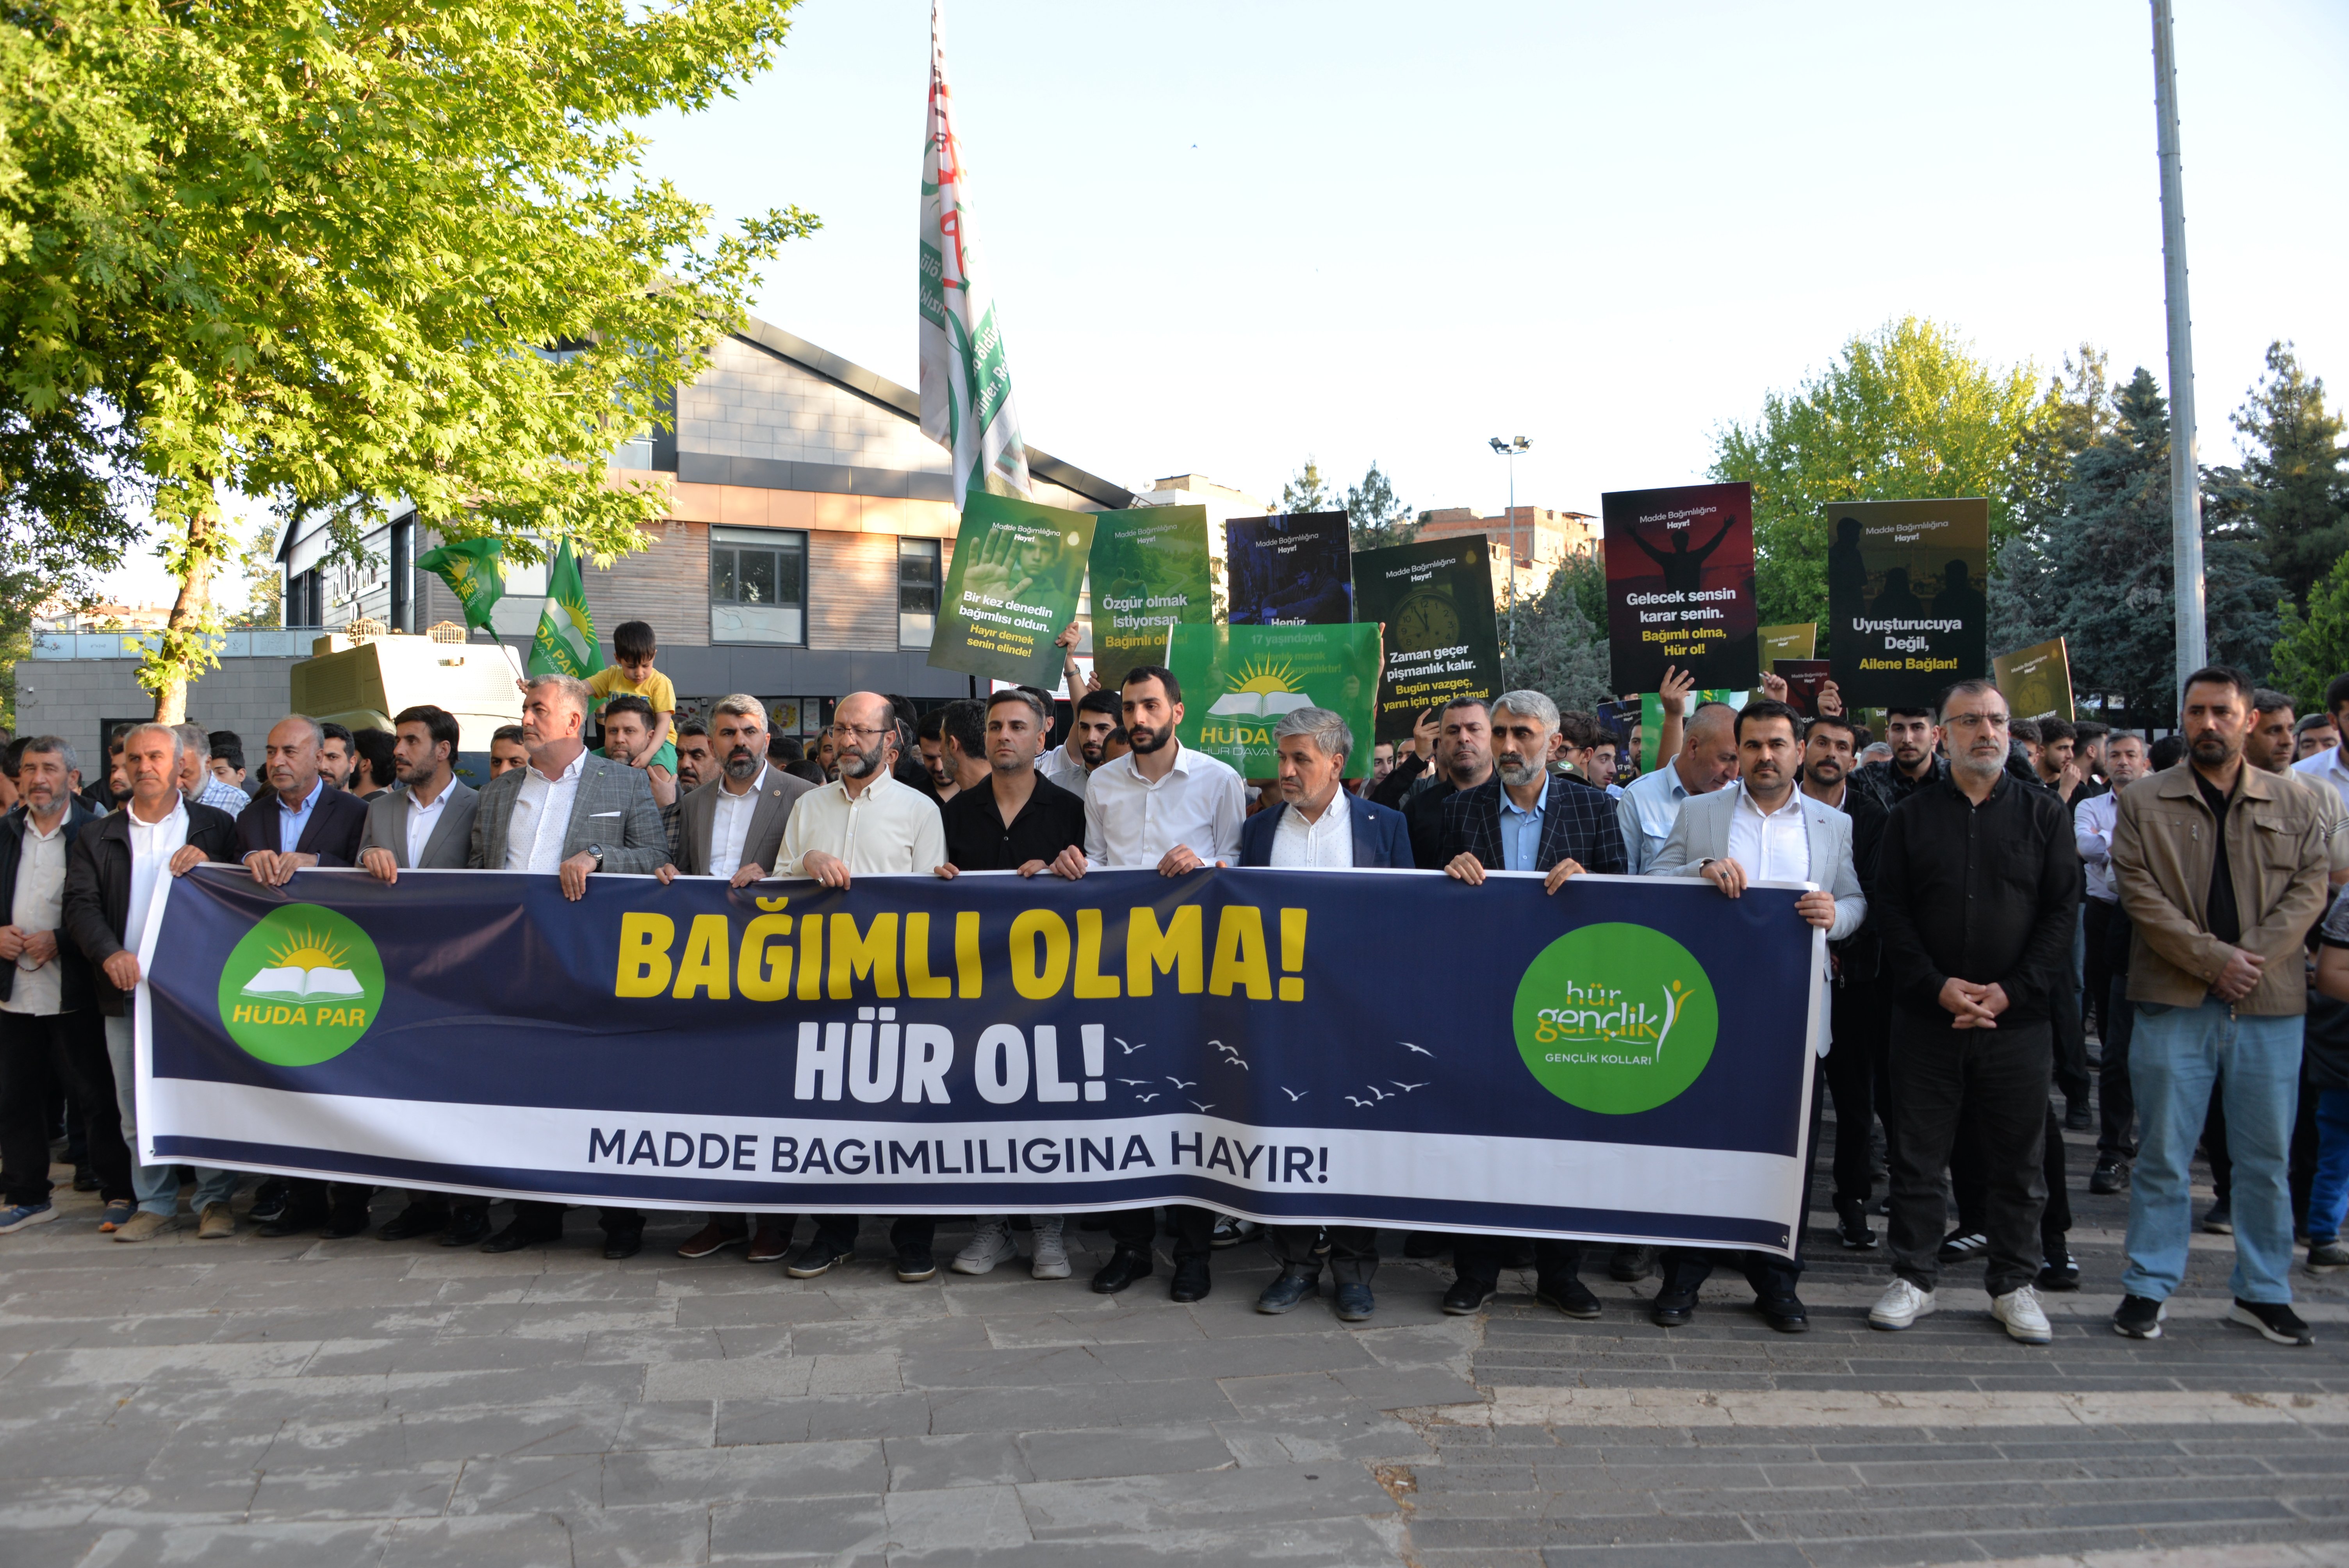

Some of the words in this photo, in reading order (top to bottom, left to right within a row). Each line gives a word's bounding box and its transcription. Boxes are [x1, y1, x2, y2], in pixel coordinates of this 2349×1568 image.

[1640, 513, 1666, 523] Madde
[1668, 506, 1716, 519] Bağımlılığına
[992, 522, 1016, 531] Madde
[1018, 525, 1060, 537] Bağımlılığına
[1115, 530, 1136, 539] Madde
[1138, 524, 1177, 535] Bağımlılığına
[1667, 519, 1690, 529] Hayır!
[1866, 526, 1895, 535] Madde
[1896, 521, 1948, 533] Bağımlılığına
[1014, 533, 1035, 543] Hayır!
[1137, 535, 1156, 544] Hayır!
[1256, 538, 1278, 548] Madde
[1279, 533, 1319, 544] Bağımlılığına
[1895, 533, 1919, 543] Hayır!
[1278, 545, 1297, 554] Hayır!
[1386, 567, 1410, 578] Madde
[1411, 558, 1456, 572] Bağımlılığına
[1411, 571, 1432, 582] Hayır!
[963, 591, 981, 603] Bir
[982, 594, 1004, 608] kez
[1005, 600, 1053, 618] denedin
[1103, 594, 1143, 612] Özgür
[1146, 593, 1187, 608] olmak
[1626, 590, 1685, 606] Gelecek
[1688, 588, 1736, 602] sensin
[959, 605, 1012, 625] bağımlısı
[1014, 618, 1050, 633] oldun.
[1113, 615, 1182, 630] istiyorsan.
[1271, 617, 1306, 628] Henüz
[1640, 611, 1677, 623] karar
[1681, 607, 1724, 620] senin.
[1853, 617, 1962, 634] Uyuşturucuya
[970, 624, 997, 637] Hayır
[999, 631, 1034, 645] demek
[1105, 634, 1151, 650] Bağımlı
[1251, 634, 1263, 644] 17
[1265, 632, 1327, 647] yaşındaydı,
[1642, 629, 1689, 643] Bağımlı
[1692, 627, 1726, 639] olma,
[967, 638, 995, 650] senin
[997, 644, 1032, 657] elinde!
[1664, 644, 1687, 656] Hür
[1690, 643, 1705, 655] ol!
[1885, 636, 1930, 653] Değil,
[1295, 651, 1326, 661] merak
[1390, 650, 1431, 663] Zaman
[1433, 645, 1469, 660] geçer
[1387, 662, 1444, 682] pişmanlık
[1446, 659, 1476, 672] kalır.
[1859, 658, 1902, 670] Ailene
[1905, 657, 1958, 672] Bağlan!
[1395, 682, 1429, 695] Bugün
[1432, 679, 1473, 690] vazgeç,
[1383, 701, 1408, 713] yarın
[1410, 696, 1429, 709] için
[1200, 727, 1269, 745] HÜDA
[1200, 747, 1230, 755] HÜR
[1233, 747, 1270, 756] DAVA
[615, 897, 982, 1001] BAĞIMLI
[1010, 905, 1307, 1001] OLMA!
[1567, 980, 1621, 1006] hür
[232, 1005, 307, 1025] HÜDA
[316, 1007, 365, 1026] PAR
[1535, 1002, 1659, 1042] gençlik
[795, 1007, 954, 1104] HÜR
[975, 1024, 1106, 1104] OL!
[1545, 1052, 1597, 1064] GENÇLİK
[1601, 1055, 1651, 1065] KOLLARI
[588, 1128, 758, 1171] MADDE
[772, 1134, 1156, 1176] BAGIMLILIGINA
[1171, 1131, 1328, 1183] HAYIR!
